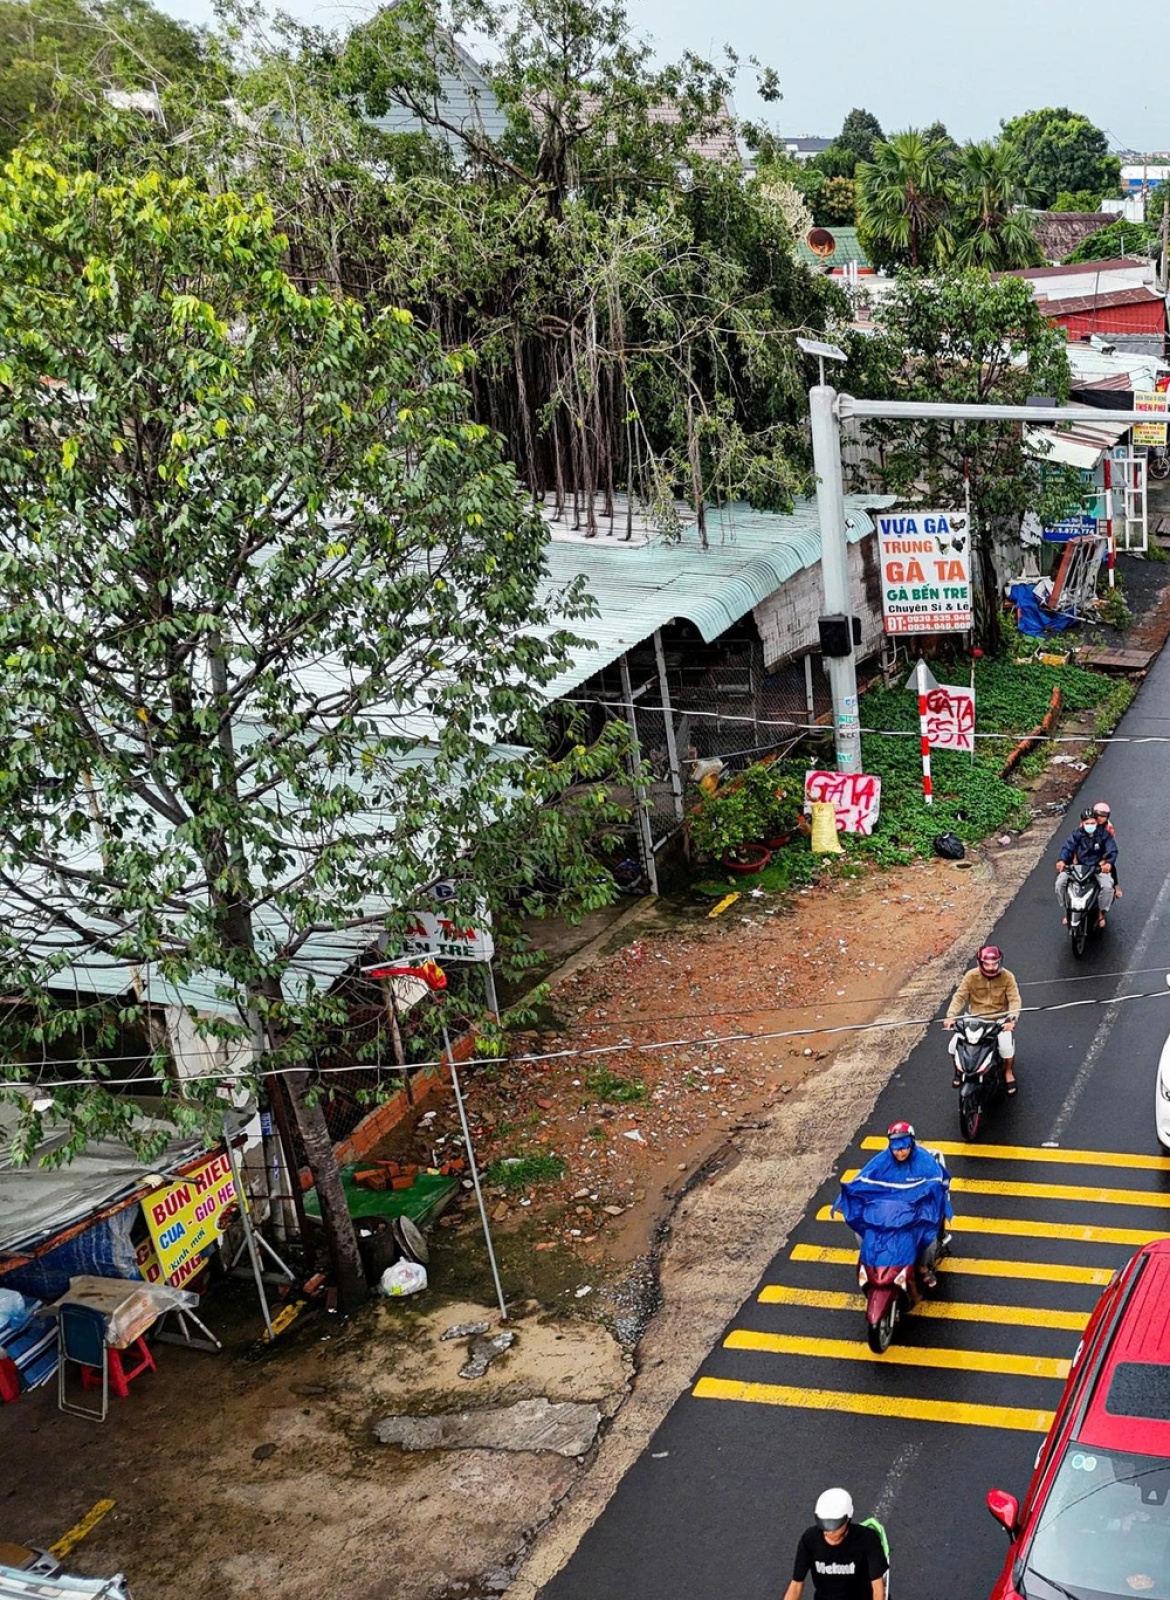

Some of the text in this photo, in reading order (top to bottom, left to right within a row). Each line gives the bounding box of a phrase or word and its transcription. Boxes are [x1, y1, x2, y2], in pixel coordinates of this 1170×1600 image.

[880, 515, 950, 538] VỰA GÀ
[883, 541, 933, 554] TRUNG
[886, 557, 966, 583] GÀ TA
[887, 584, 968, 600] GÀ BẾN TRE
[888, 604, 928, 613] Chuyên
[436, 943, 476, 957] TRE
[151, 1184, 192, 1227] BÚN
[158, 1221, 186, 1250] CUA
[194, 1194, 216, 1223] GIÒ
